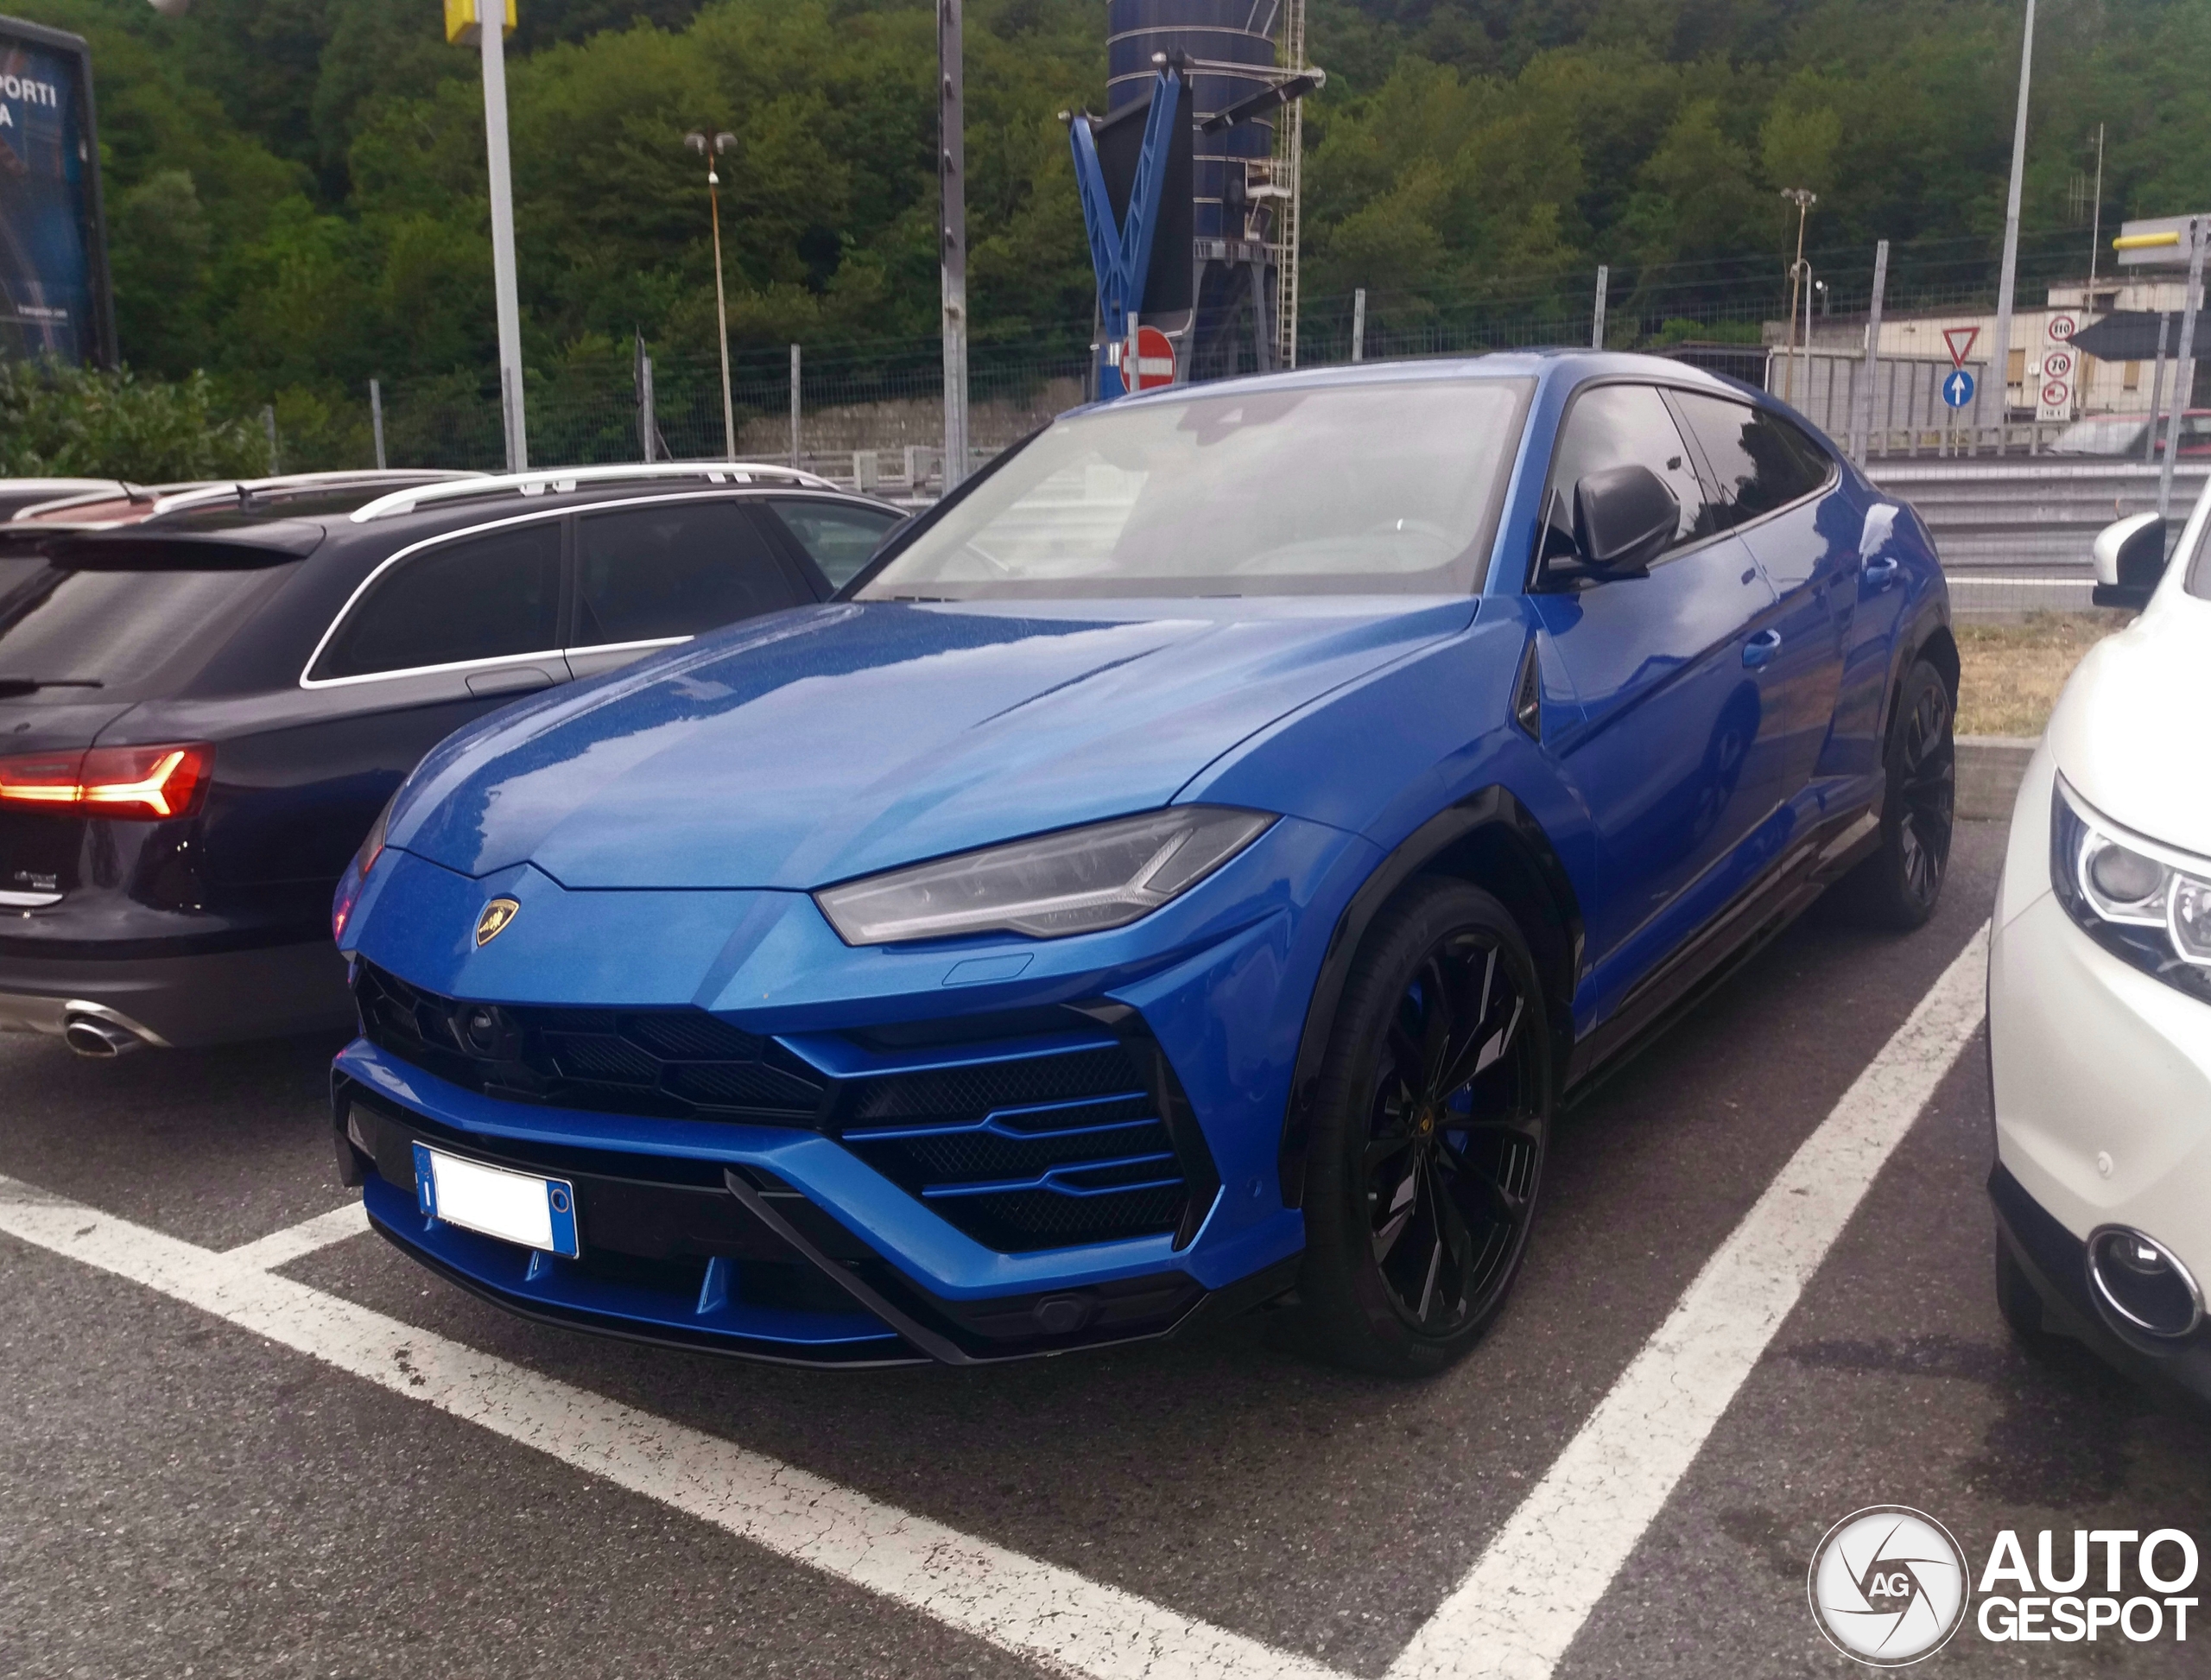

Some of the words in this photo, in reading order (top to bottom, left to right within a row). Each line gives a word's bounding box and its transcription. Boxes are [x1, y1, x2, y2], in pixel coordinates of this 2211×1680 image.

[0, 74, 56, 108] ORTI
[2055, 323, 2069, 333] 110
[2052, 358, 2066, 371] 70
